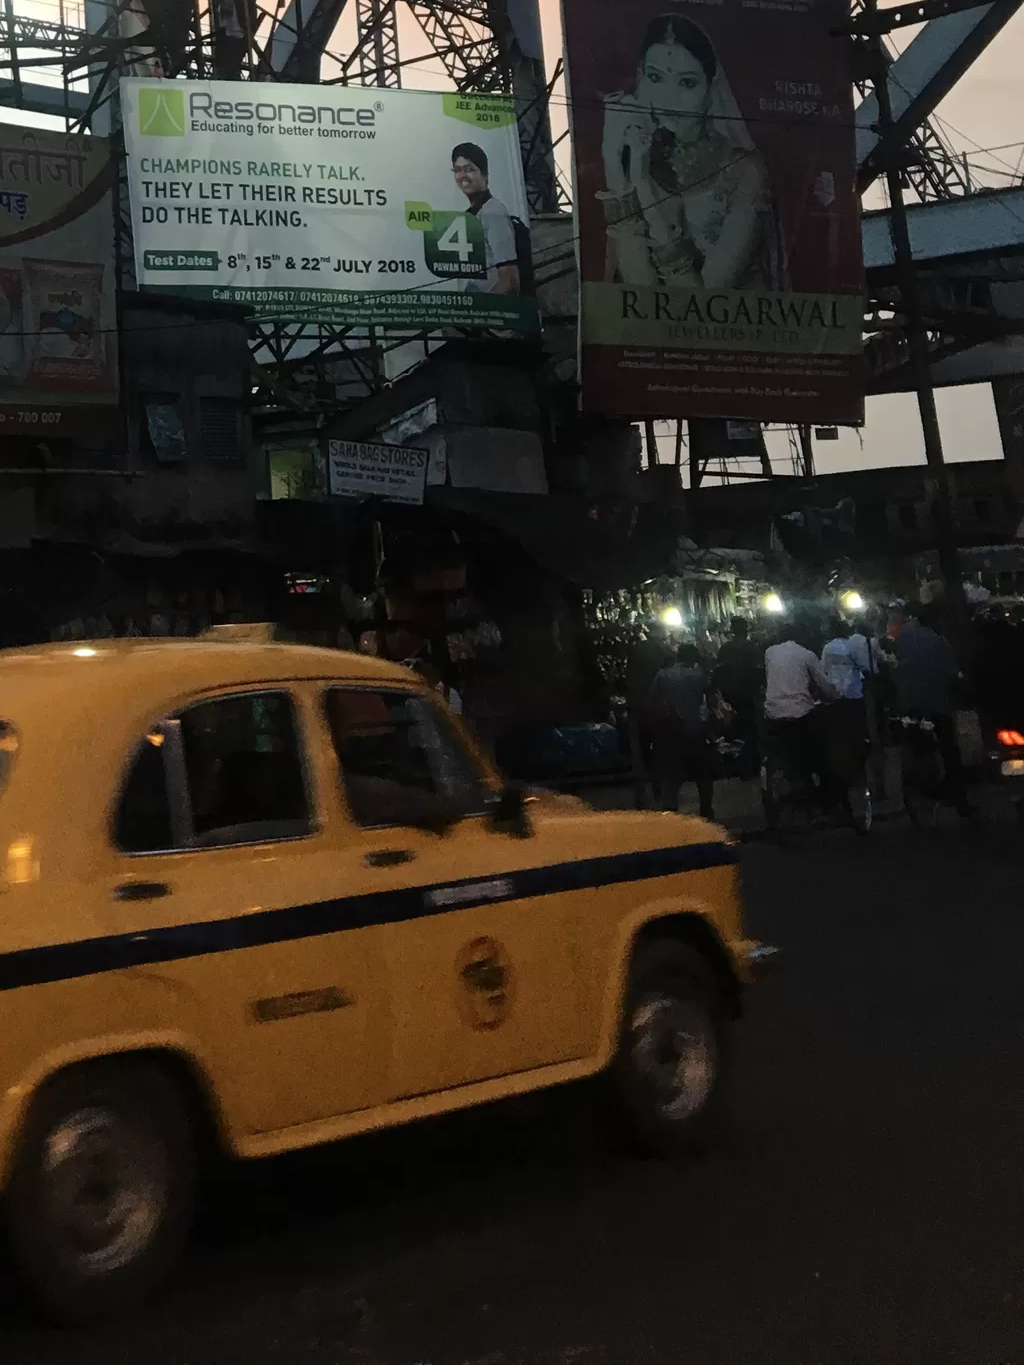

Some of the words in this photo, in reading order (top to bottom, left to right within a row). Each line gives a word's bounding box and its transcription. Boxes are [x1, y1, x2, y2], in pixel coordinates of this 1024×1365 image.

[189, 92, 376, 127] Resonance
[456, 101, 472, 110] JEE
[476, 113, 500, 122] 2018
[191, 120, 254, 136] Educating
[257, 121, 275, 135] for
[278, 123, 313, 137] better
[317, 127, 376, 139] tomorrow
[140, 158, 242, 176] CHAMPIONS
[247, 161, 313, 179] RARELY
[317, 164, 365, 182] TALK.
[141, 181, 193, 200] THEY
[199, 183, 234, 201] LET
[239, 184, 296, 203] THEIR
[302, 186, 388, 206] RESULTS
[142, 206, 168, 224] DO
[174, 207, 213, 225] THE
[218, 208, 308, 228] TALKING.
[408, 211, 430, 222] AIR
[437, 215, 474, 262] 4
[147, 255, 174, 266] Test
[177, 255, 213, 266] Dates
[285, 256, 297, 270] &
[333, 259, 373, 273] JULY
[377, 259, 416, 274] 2018
[212, 289, 233, 300] Call:
[381, 446, 425, 467] STORES
